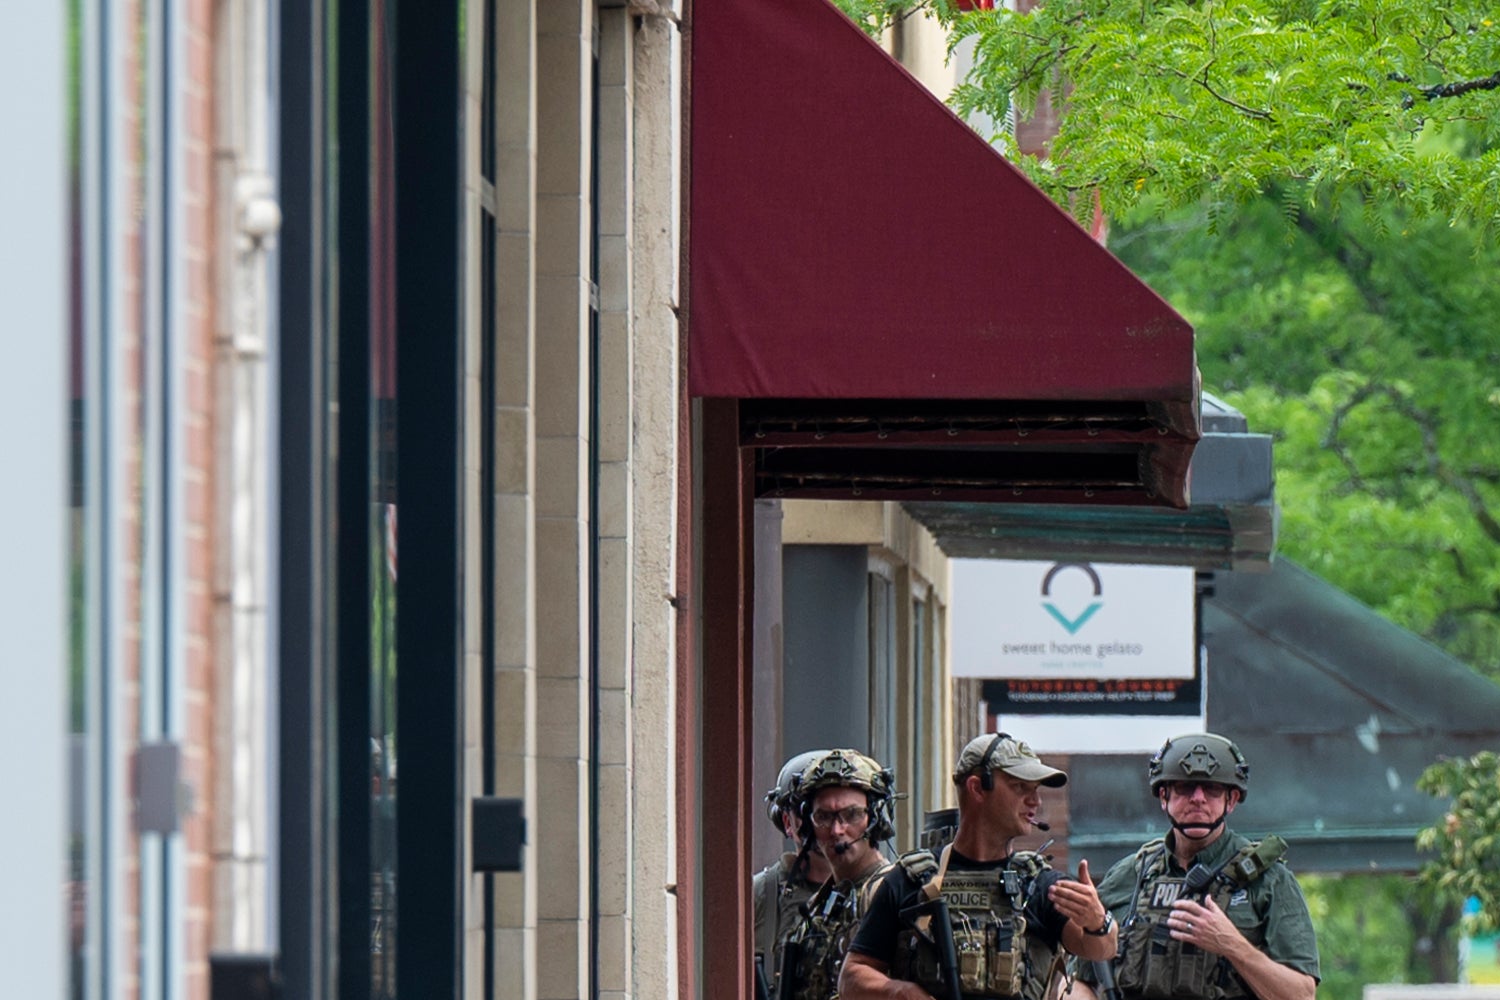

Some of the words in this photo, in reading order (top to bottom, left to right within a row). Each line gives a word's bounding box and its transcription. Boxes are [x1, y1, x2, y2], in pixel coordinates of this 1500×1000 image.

[1002, 642, 1045, 655] sweet
[1050, 640, 1092, 655] home
[1097, 641, 1143, 658] gelato
